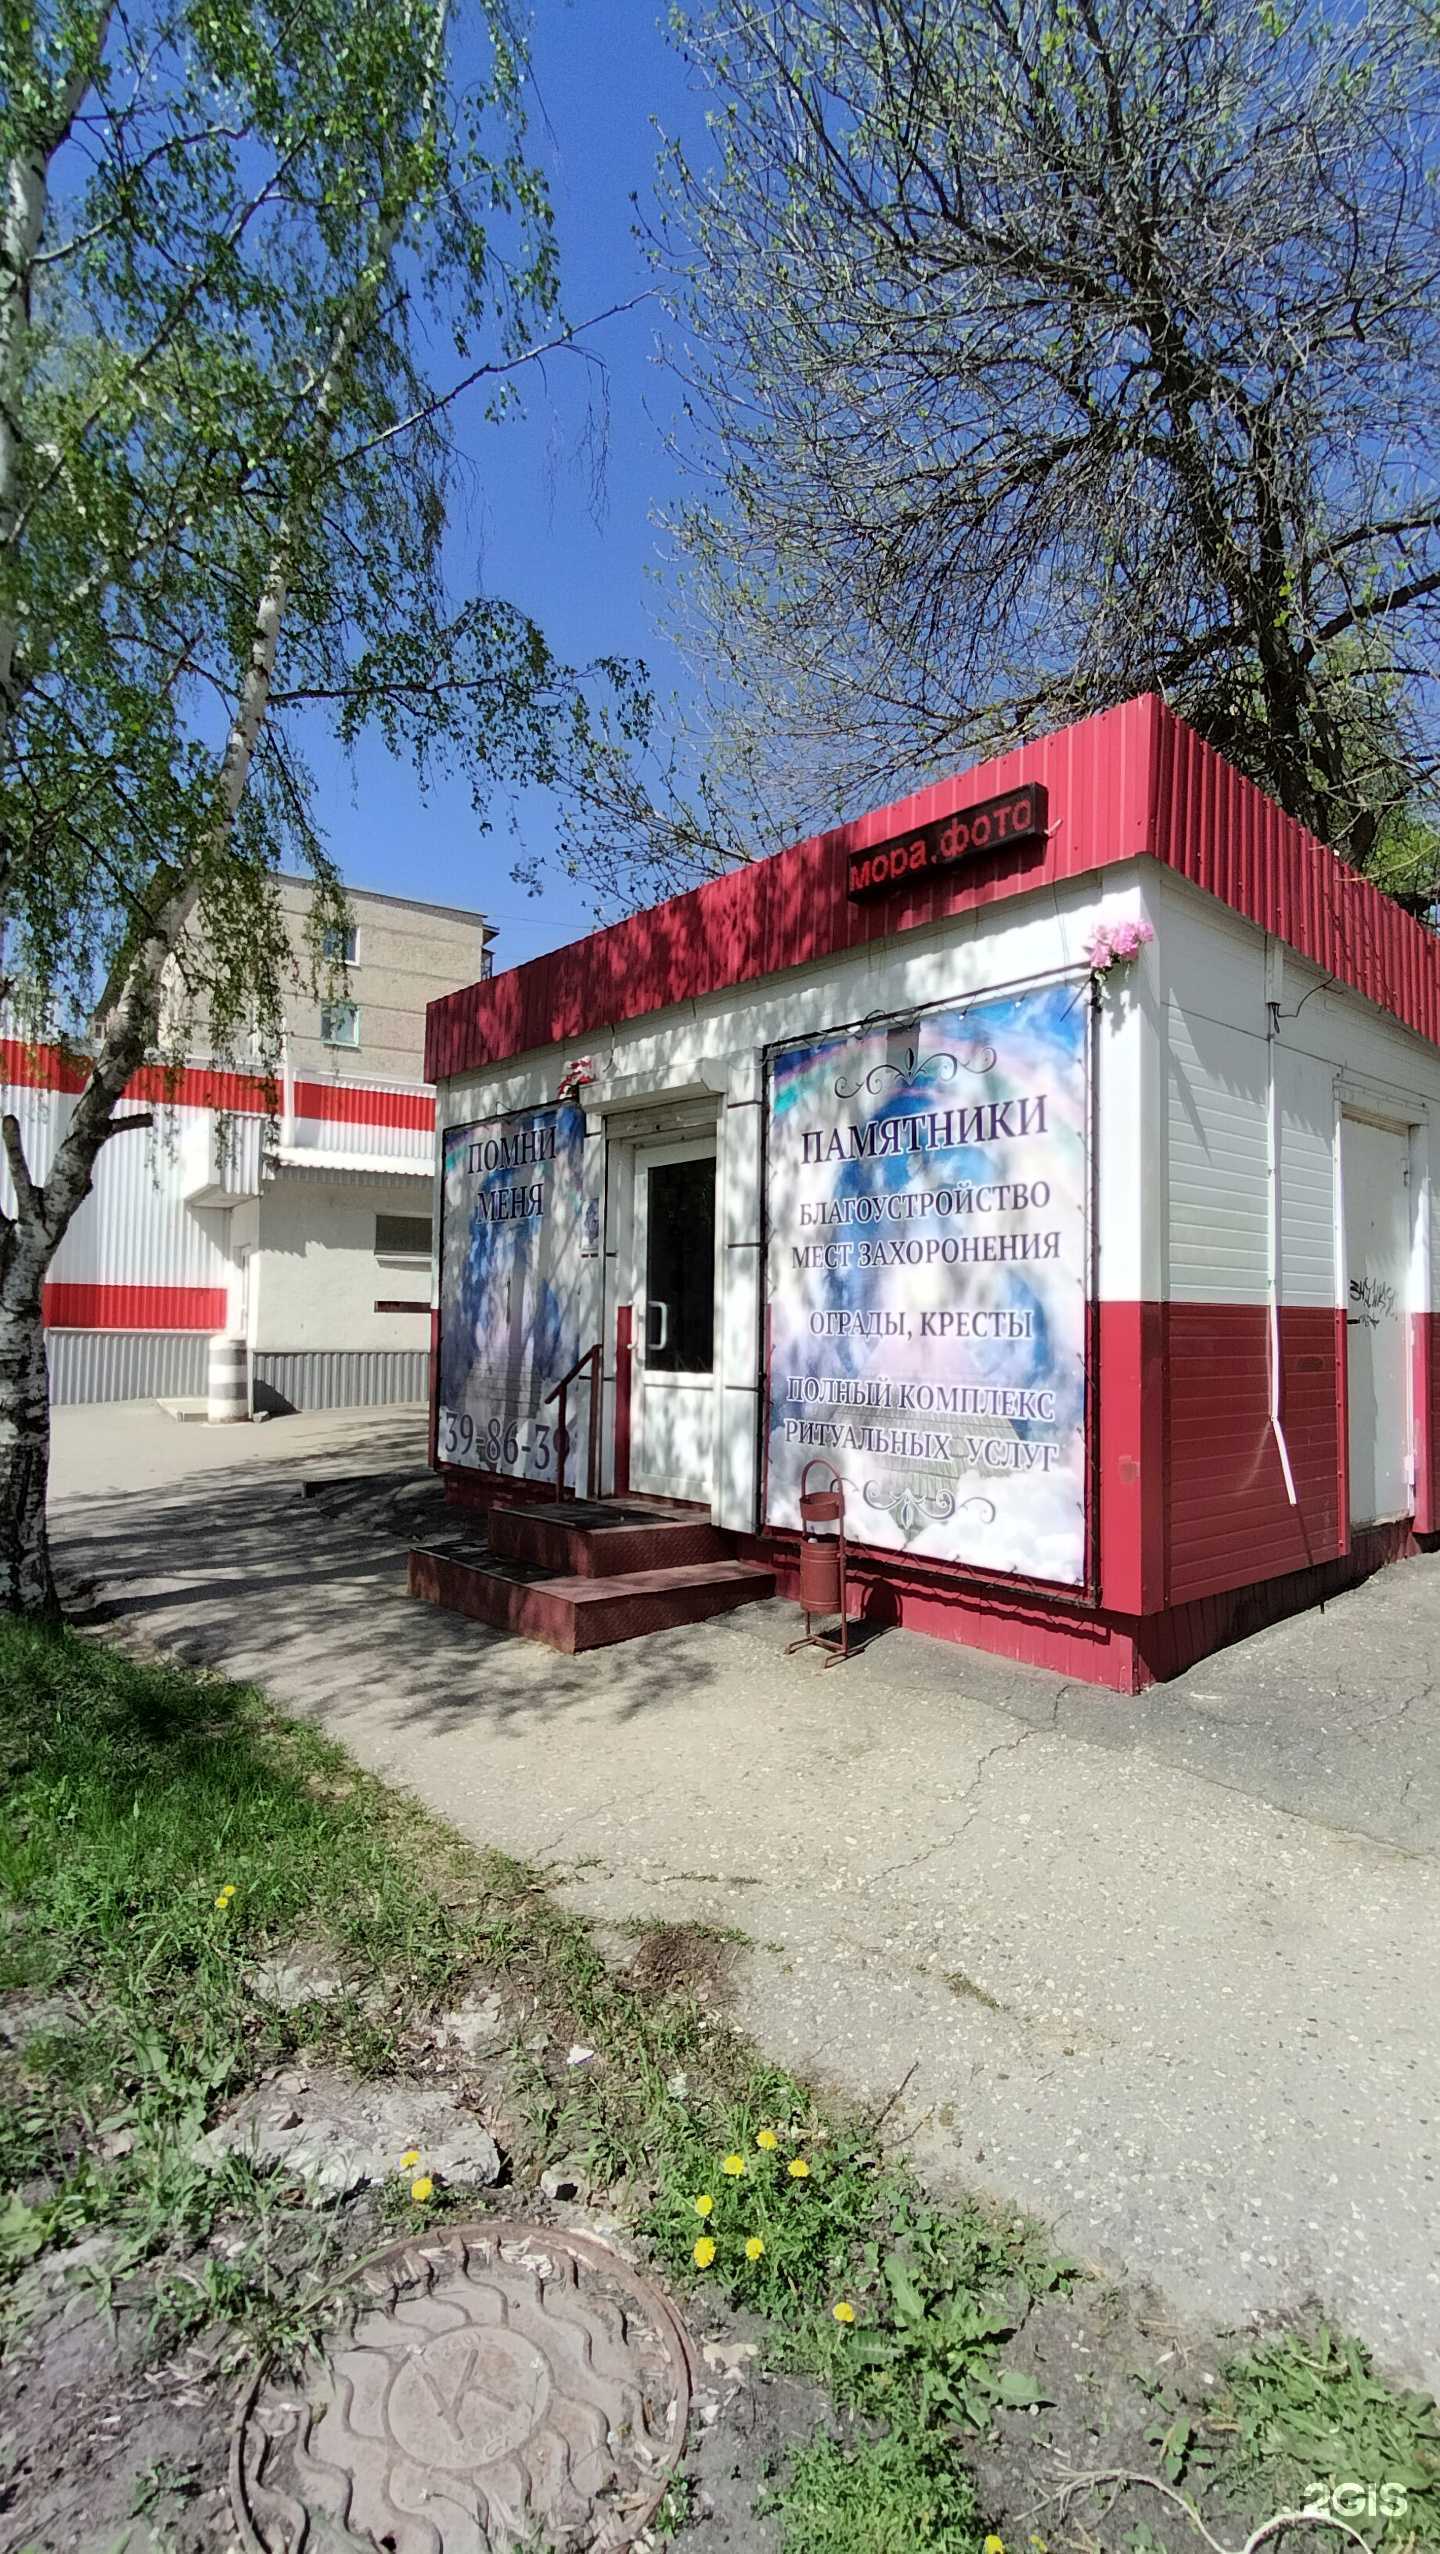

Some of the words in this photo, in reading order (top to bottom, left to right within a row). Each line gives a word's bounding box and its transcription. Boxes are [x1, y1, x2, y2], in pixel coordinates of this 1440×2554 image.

[467, 1126, 557, 1174] ПОМНИ
[800, 1095, 1048, 1165] ПАМЯТНИКИ
[477, 1183, 544, 1224] МЕНЯ
[799, 1180, 1050, 1226] БЛАГОУСТРОЙСТВО
[791, 1244, 850, 1269] МЕСТ
[860, 1232, 1062, 1268] ЗАХОРОНЕНИЯ
[810, 1311, 913, 1340] ОГРАДЫ,
[920, 1311, 1033, 1339] КРЕСТЫ
[787, 1377, 892, 1408] ПОЛНЫЙ
[898, 1385, 1055, 1420] КОМПЛЕКС
[784, 1420, 951, 1461] РИТУАЛЬНЫХ
[968, 1438, 1059, 1472] УСЛУГ
